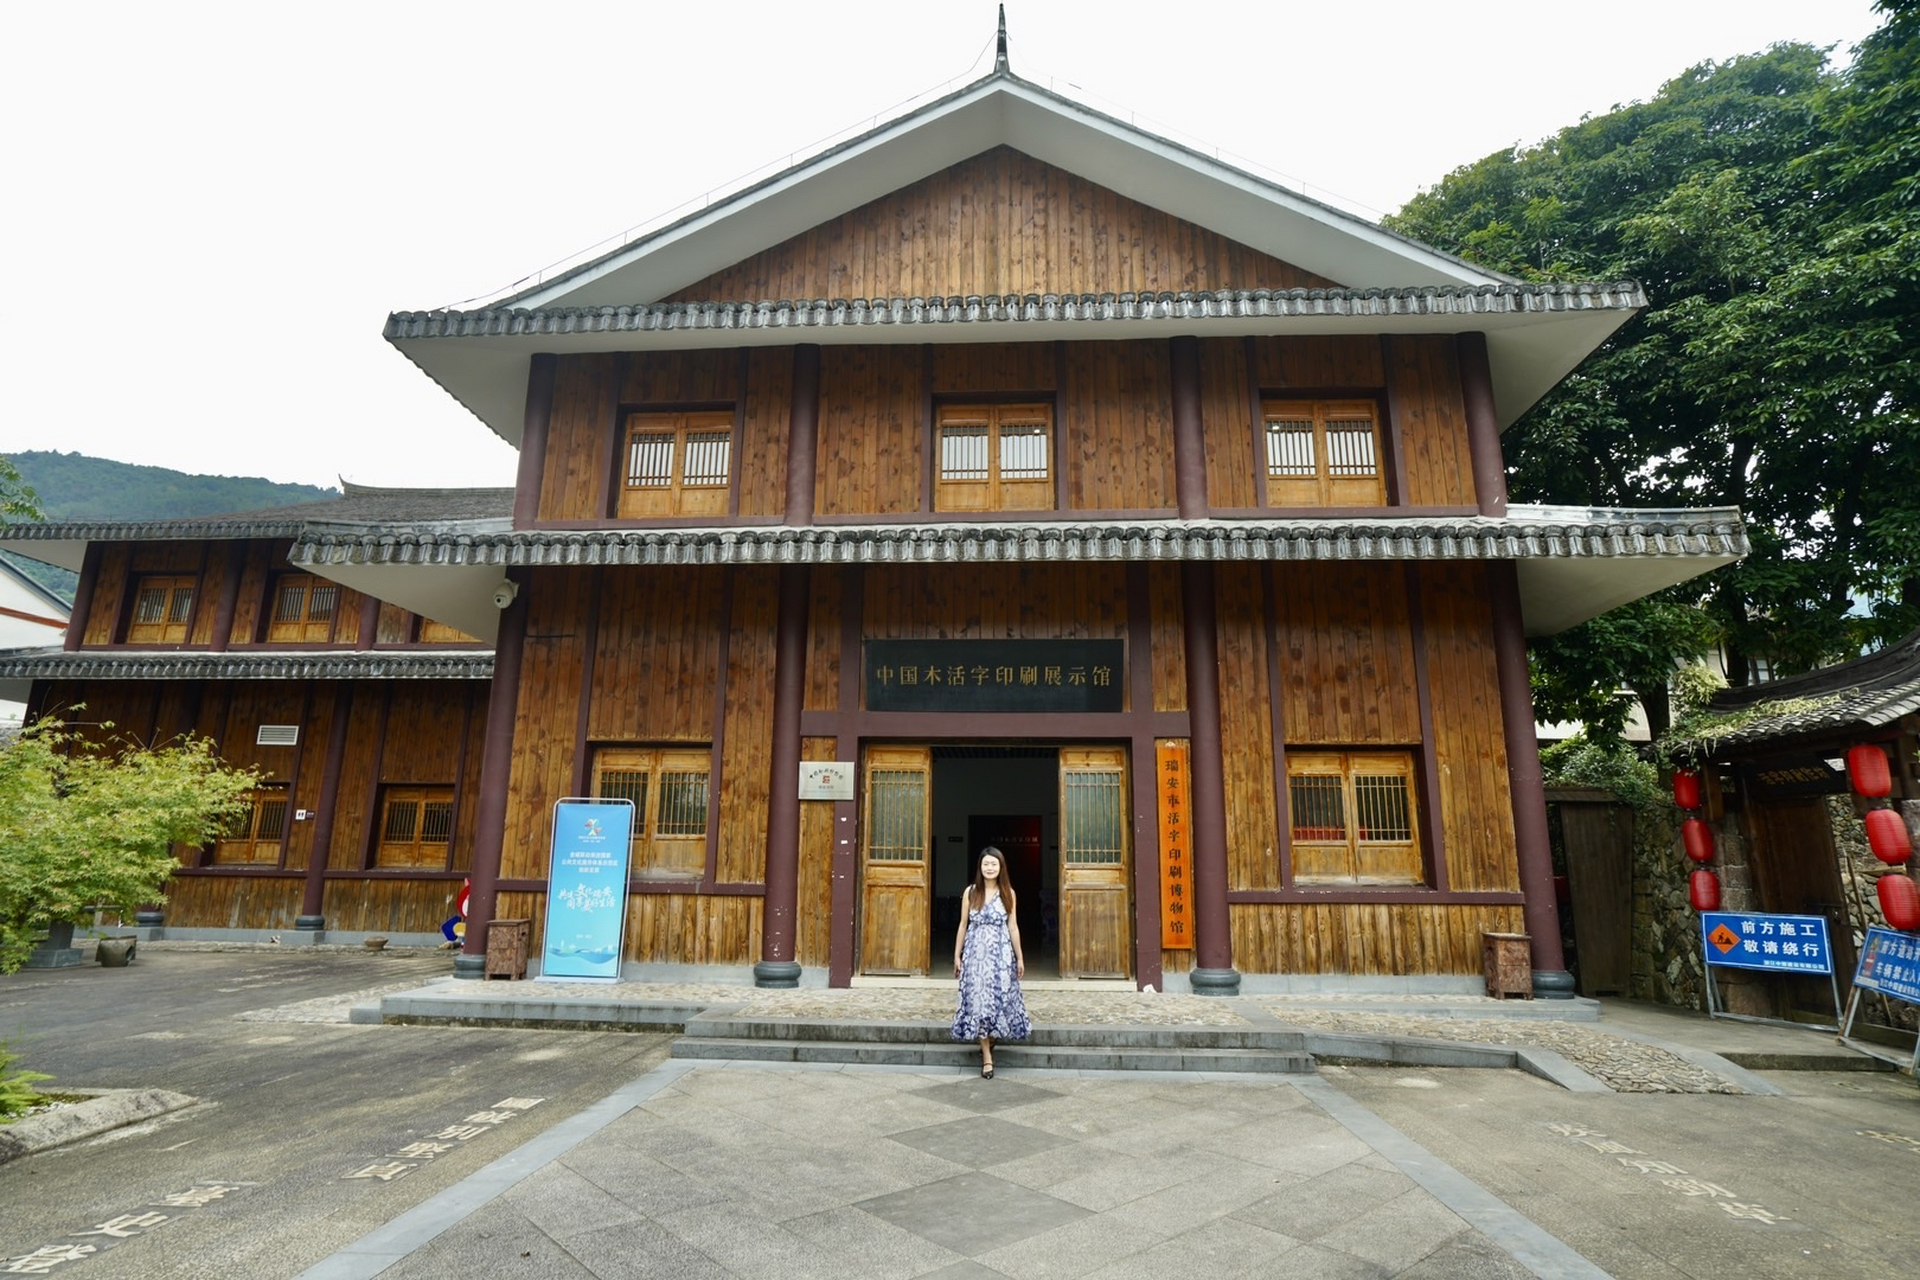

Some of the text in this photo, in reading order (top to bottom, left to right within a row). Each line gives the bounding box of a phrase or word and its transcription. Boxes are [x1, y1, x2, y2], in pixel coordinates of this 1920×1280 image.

[876, 664, 1112, 687] 中国木活字印刷展示馆
[1165, 759, 1185, 934] 瑞安市活字印刷博物馆
[1741, 920, 1818, 936] 前方施工
[1743, 939, 1819, 957] 敬请绕行
